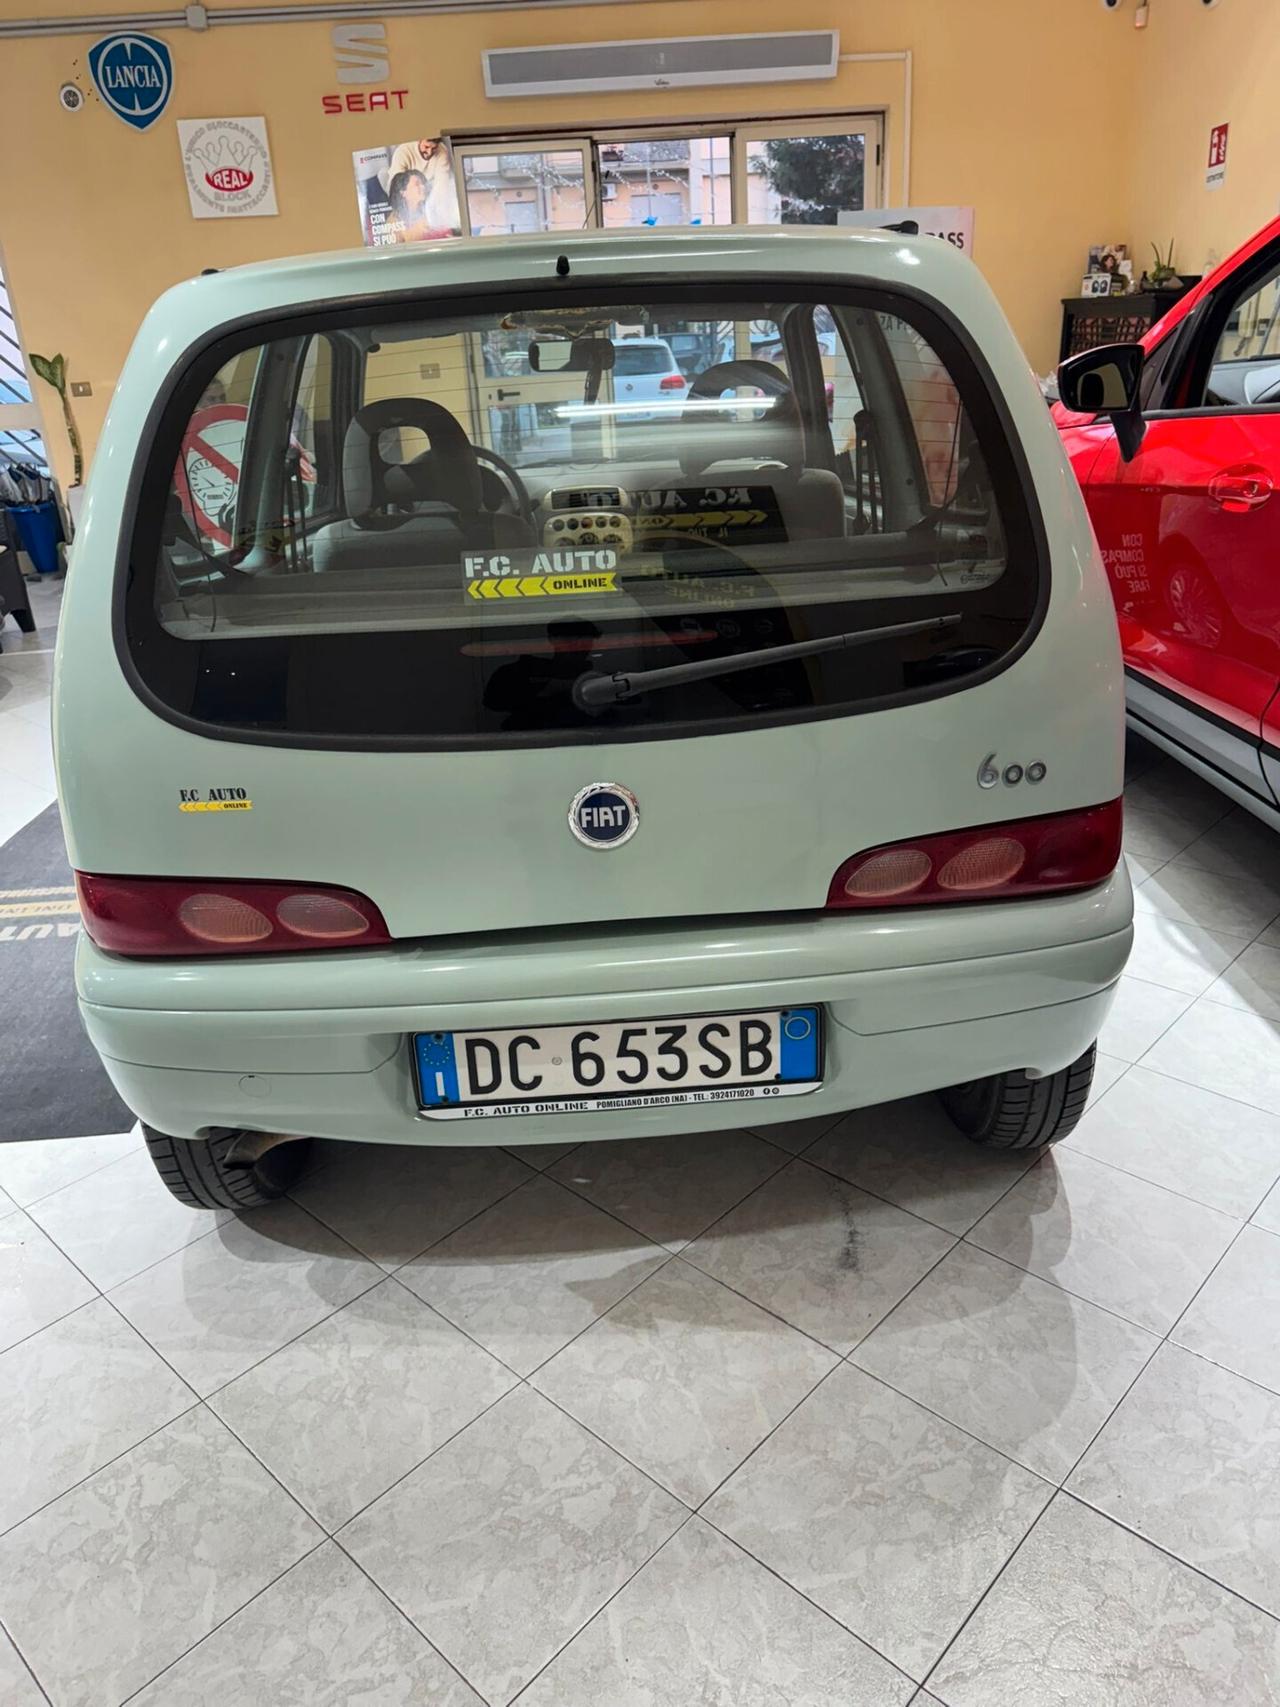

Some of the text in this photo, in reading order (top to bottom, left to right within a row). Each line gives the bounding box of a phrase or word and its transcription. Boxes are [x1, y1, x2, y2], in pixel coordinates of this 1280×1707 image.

[105, 65, 162, 88] LANCIA
[322, 90, 409, 114] SEAT
[213, 170, 248, 189] REAL
[370, 213, 386, 225] CON
[373, 236, 382, 247] SI
[465, 549, 617, 578] F.C. AUTO
[553, 577, 607, 590] ONLINE
[977, 752, 1047, 790] 600
[208, 787, 247, 801] AUTO
[581, 805, 626, 828] FIAT
[0, 923, 80, 940] AUT
[465, 1034, 543, 1095] DC
[570, 1019, 773, 1087] 653SB
[464, 1108, 489, 1117] F.C.
[493, 1105, 530, 1115] AUTO
[535, 1102, 589, 1113] ONLINE
[596, 1099, 642, 1109] POMIGLIANO
[643, 1095, 671, 1105] D'ARCO
[710, 1089, 755, 1100] 3924171020
